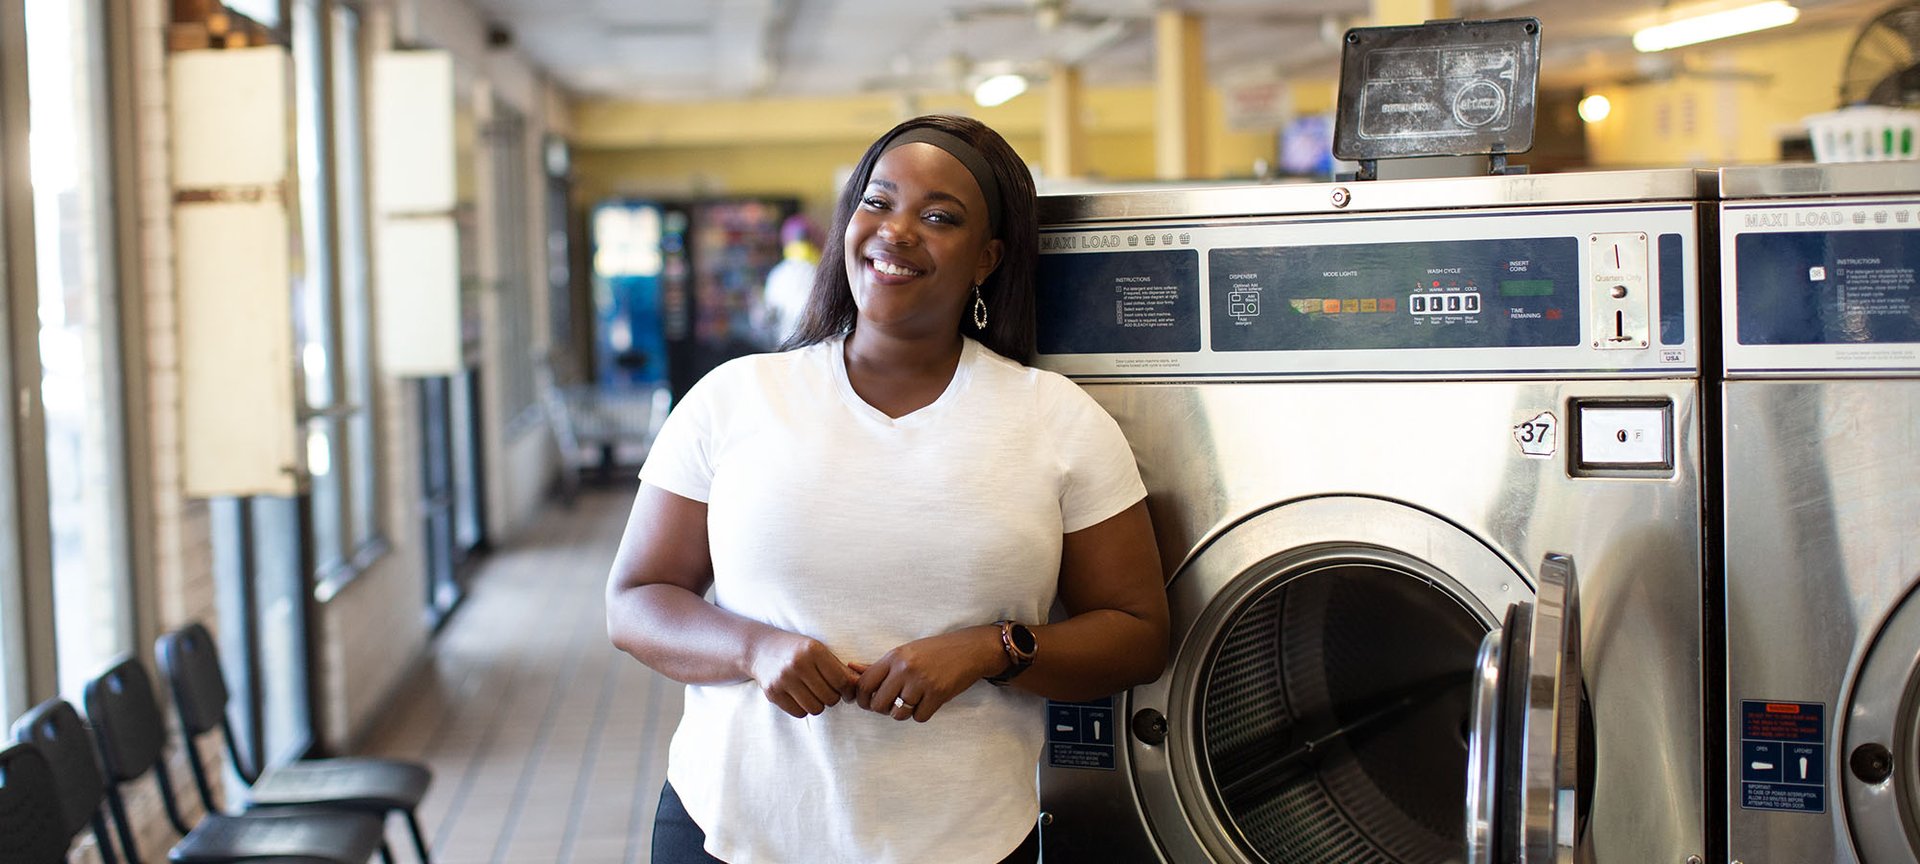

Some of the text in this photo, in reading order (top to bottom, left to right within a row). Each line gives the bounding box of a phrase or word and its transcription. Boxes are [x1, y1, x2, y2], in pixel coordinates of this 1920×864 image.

[1745, 212, 1843, 227] MAXI LOAD
[1041, 235, 1121, 249] MAXI LOAD
[1626, 274, 1642, 282] Only
[1521, 423, 1550, 443] 37
[1635, 432, 1641, 440] F
